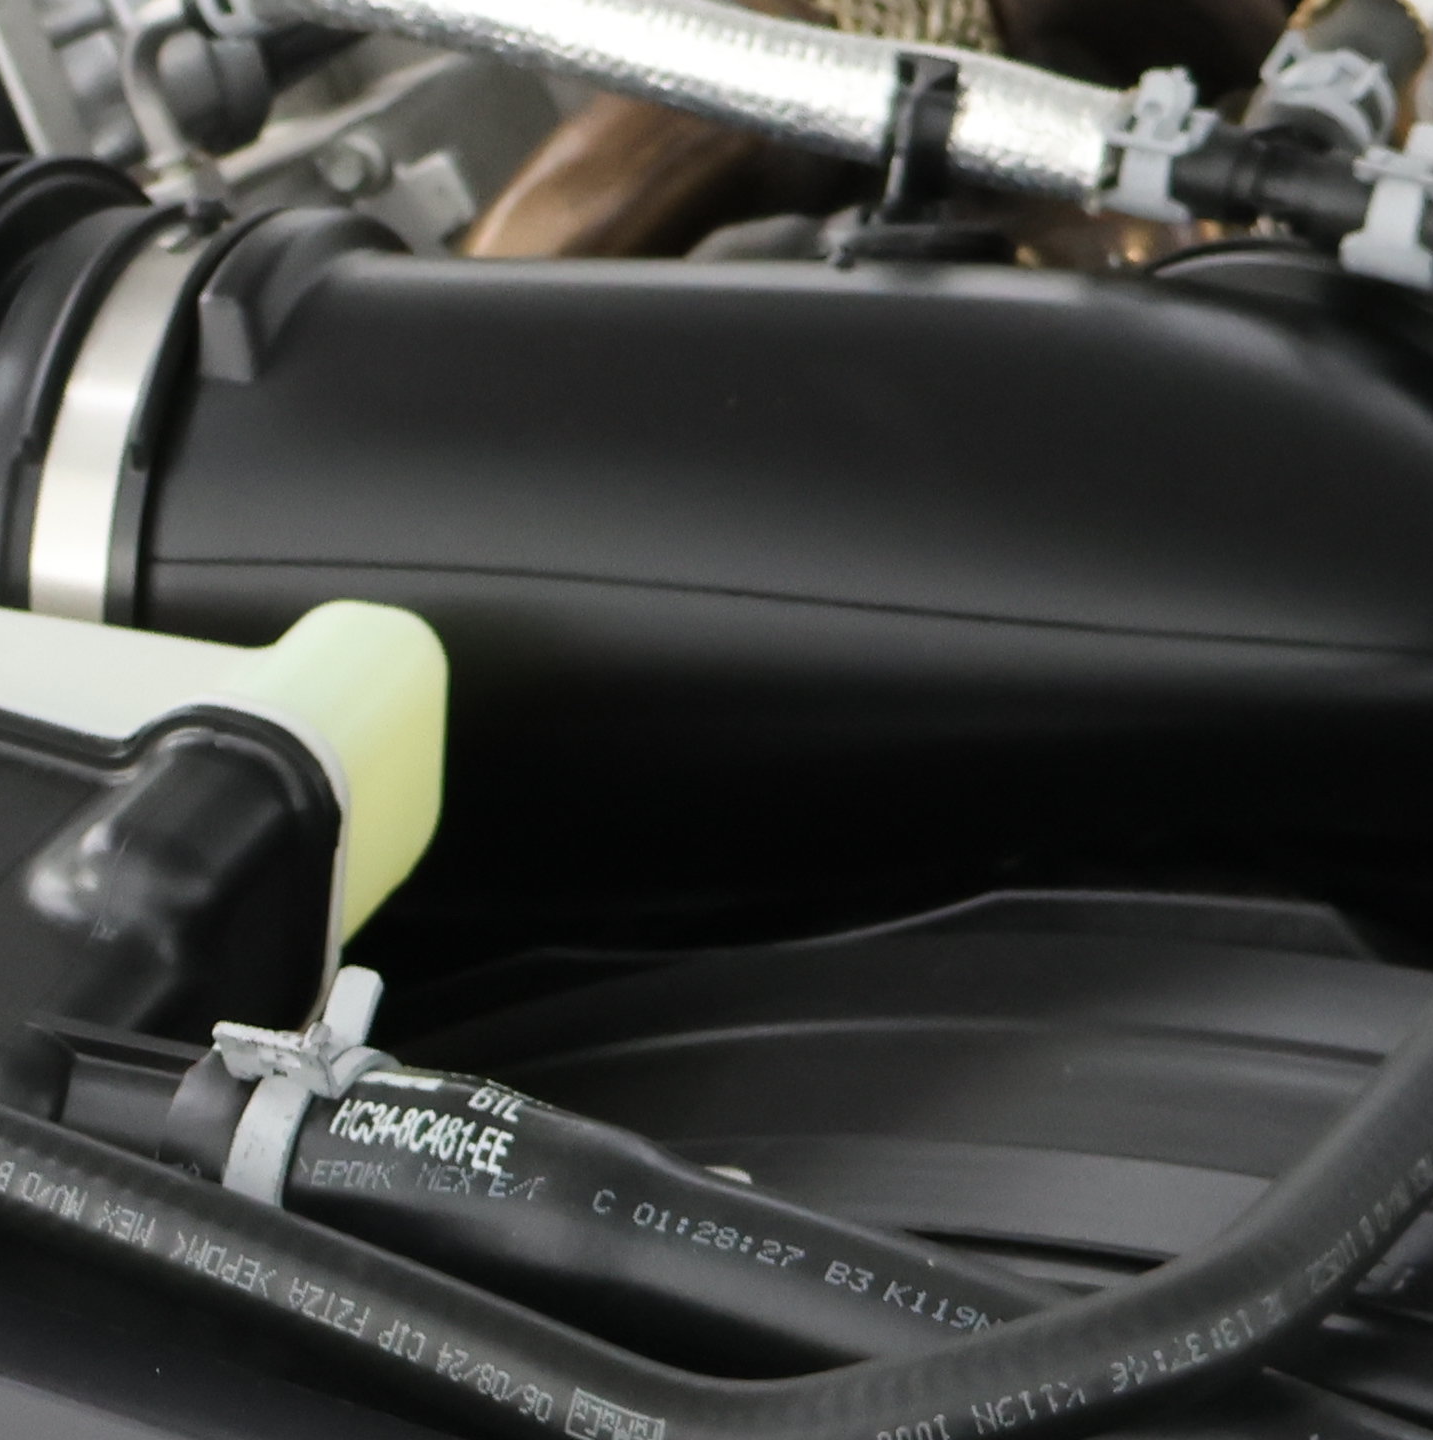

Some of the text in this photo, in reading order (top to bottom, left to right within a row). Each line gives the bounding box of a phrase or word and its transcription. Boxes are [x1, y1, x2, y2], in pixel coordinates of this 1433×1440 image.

[329, 1098, 515, 1176] HC34-8C481-EE
[95, 1201, 157, 1250] MEX
[417, 1162, 477, 1194] MEX
[592, 1189, 616, 1215] C
[632, 1202, 806, 1268] 01:28:27
[824, 1260, 875, 1293] B3
[377, 1319, 426, 1364] CIP
[435, 1343, 554, 1423] 06/08/24
